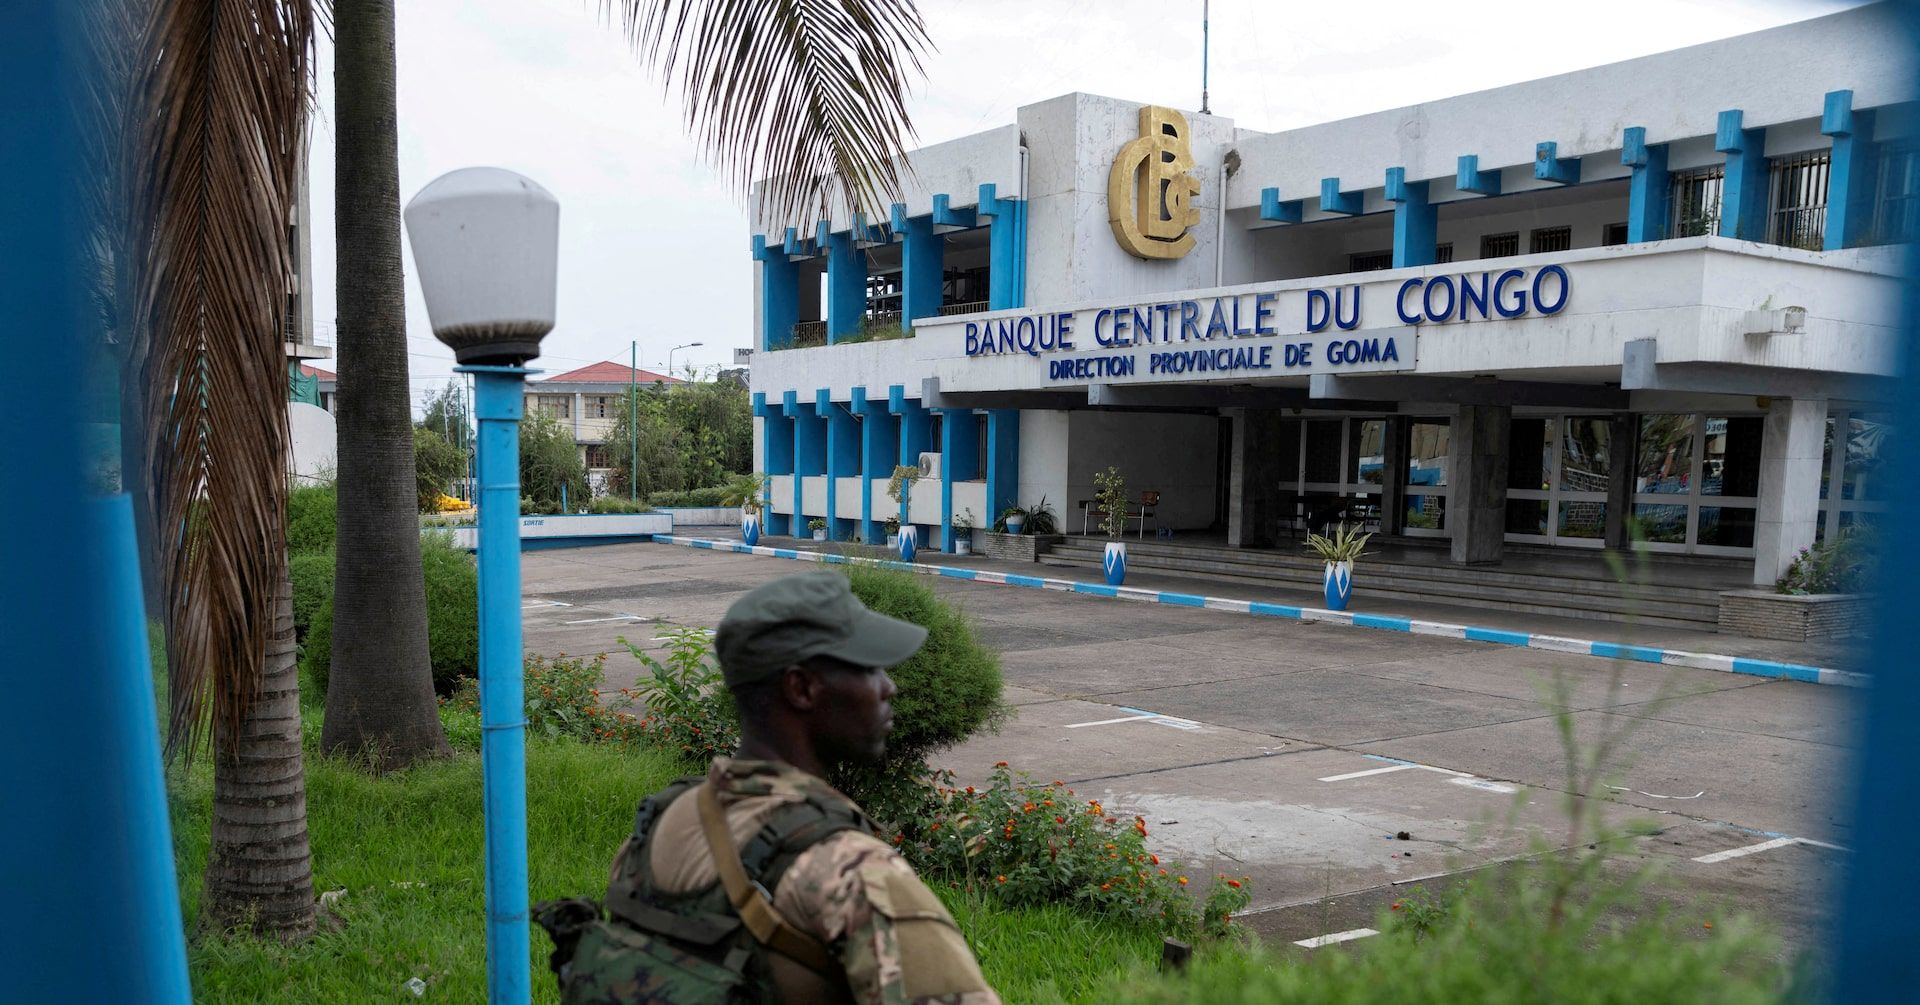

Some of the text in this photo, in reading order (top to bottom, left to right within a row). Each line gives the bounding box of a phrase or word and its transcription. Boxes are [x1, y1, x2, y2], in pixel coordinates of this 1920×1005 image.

[965, 264, 1572, 357] BANQUE CENTRALE DU CONGO
[1049, 337, 1399, 381] DIRECTION PROVINCIALE DE GOMA
